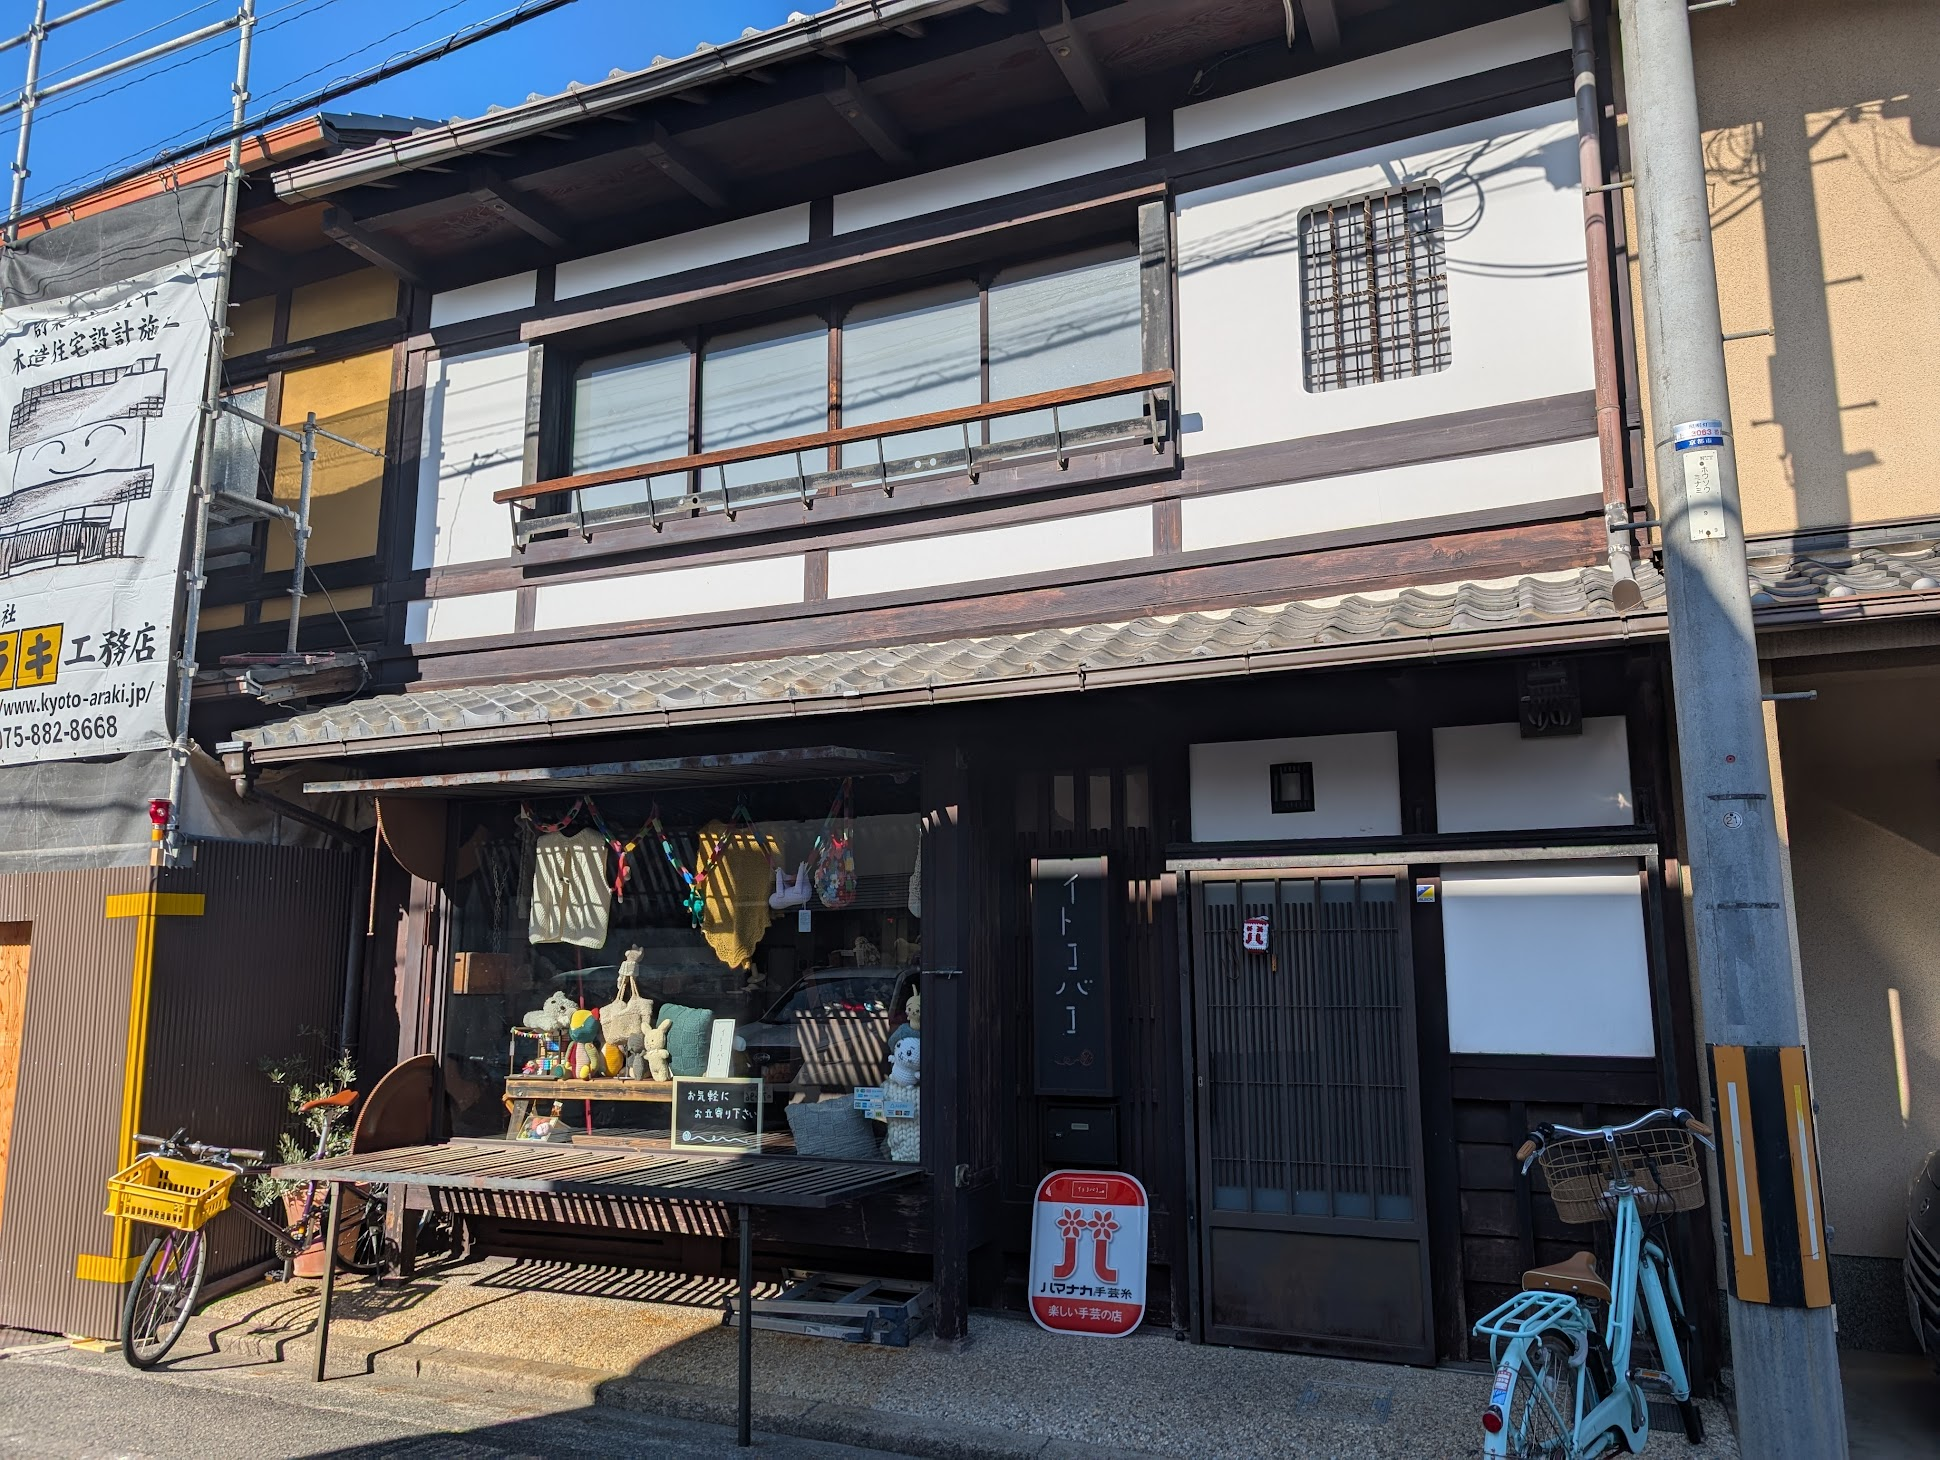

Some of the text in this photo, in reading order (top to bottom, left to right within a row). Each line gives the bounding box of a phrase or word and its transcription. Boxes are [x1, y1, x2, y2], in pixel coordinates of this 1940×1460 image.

[0, 603, 17, 628] 社
[1725, 816, 1738, 825] 21
[1056, 873, 1093, 1034] イトコバコ
[687, 1090, 730, 1102] お気軽に
[1040, 1281, 1133, 1300] ハマナカ手芸糸
[1048, 1304, 1123, 1323] 楽しい手芸の店
